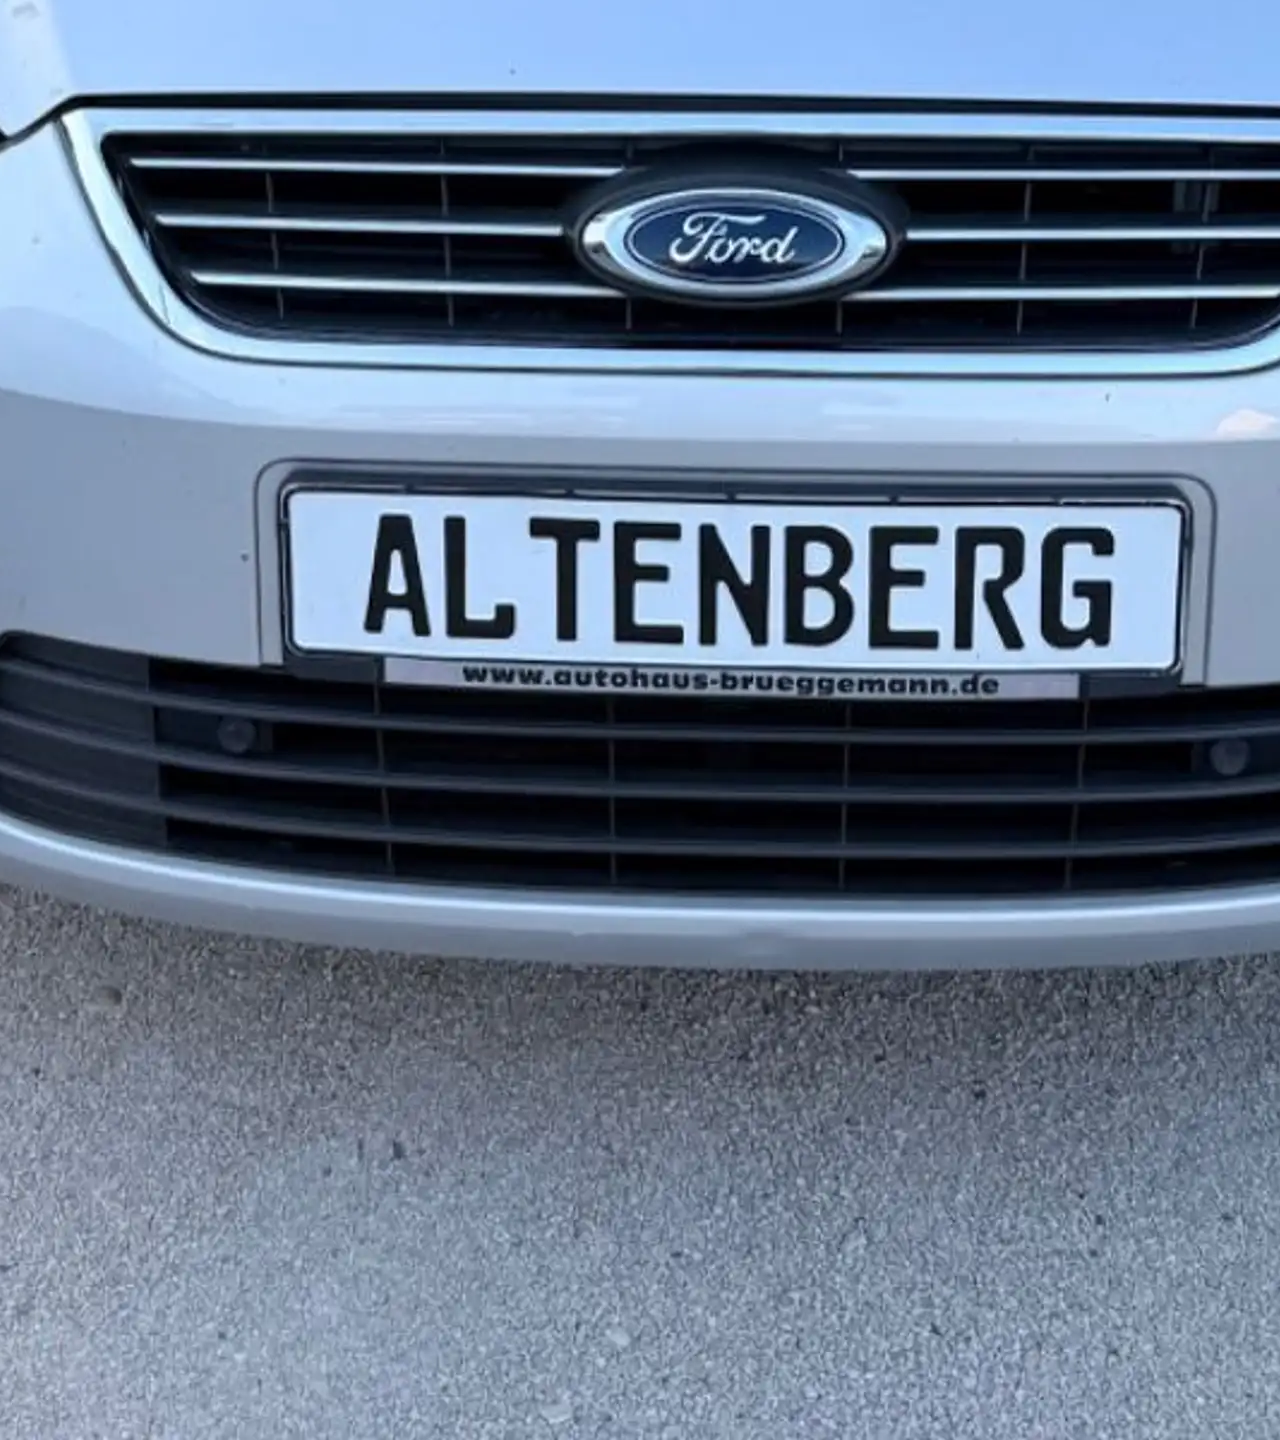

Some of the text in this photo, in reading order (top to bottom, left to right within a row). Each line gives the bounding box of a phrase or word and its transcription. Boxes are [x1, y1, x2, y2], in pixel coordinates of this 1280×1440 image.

[669, 211, 800, 265] Ford
[363, 513, 1116, 651] ALTENBERG
[462, 663, 1001, 698] www.autohaus-brueggemann.de
